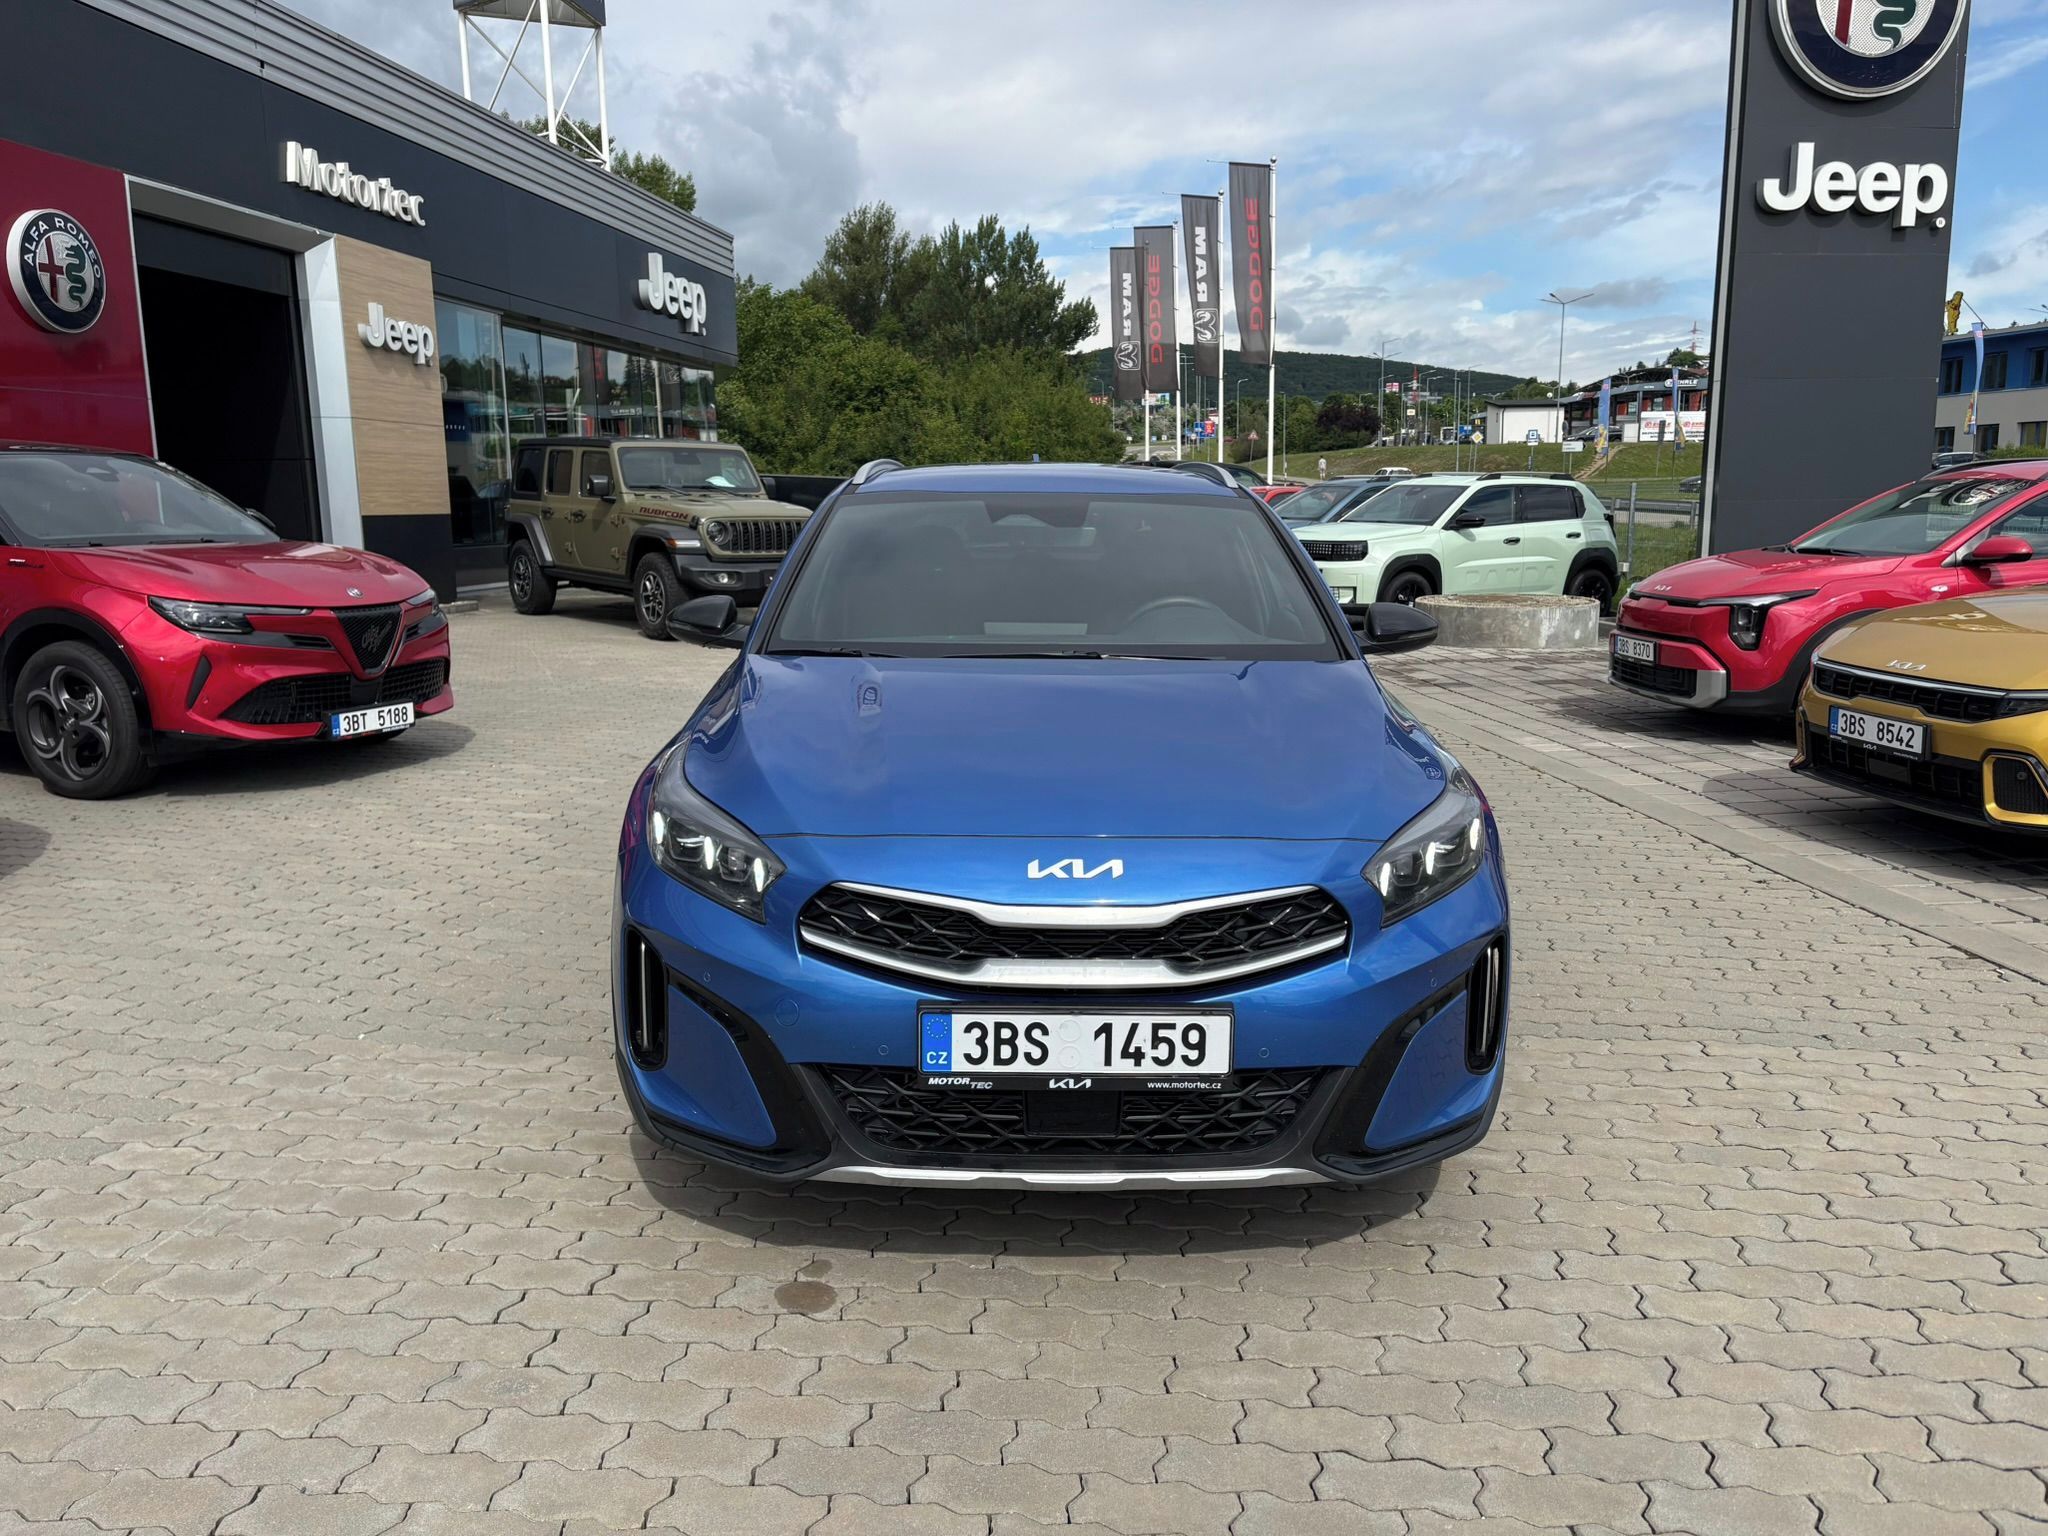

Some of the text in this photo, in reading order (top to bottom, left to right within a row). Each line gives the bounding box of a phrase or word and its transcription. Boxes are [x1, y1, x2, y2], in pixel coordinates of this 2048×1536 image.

[285, 140, 426, 226] Motortec
[1757, 141, 1948, 228] Jeep
[23, 216, 101, 279] ALFA ROMEO
[638, 252, 707, 333] Jeep
[357, 302, 435, 365] Jeep
[640, 506, 689, 520] RUBICON
[1633, 641, 1651, 658] 8370
[343, 712, 367, 733] 3BT
[378, 706, 408, 727] 5188
[1840, 713, 1866, 737] 3BS
[1876, 720, 1915, 749] 8542
[926, 1021, 1207, 1067] CZ 3BS 1459
[1147, 1081, 1222, 1089] www.motortec.cz
